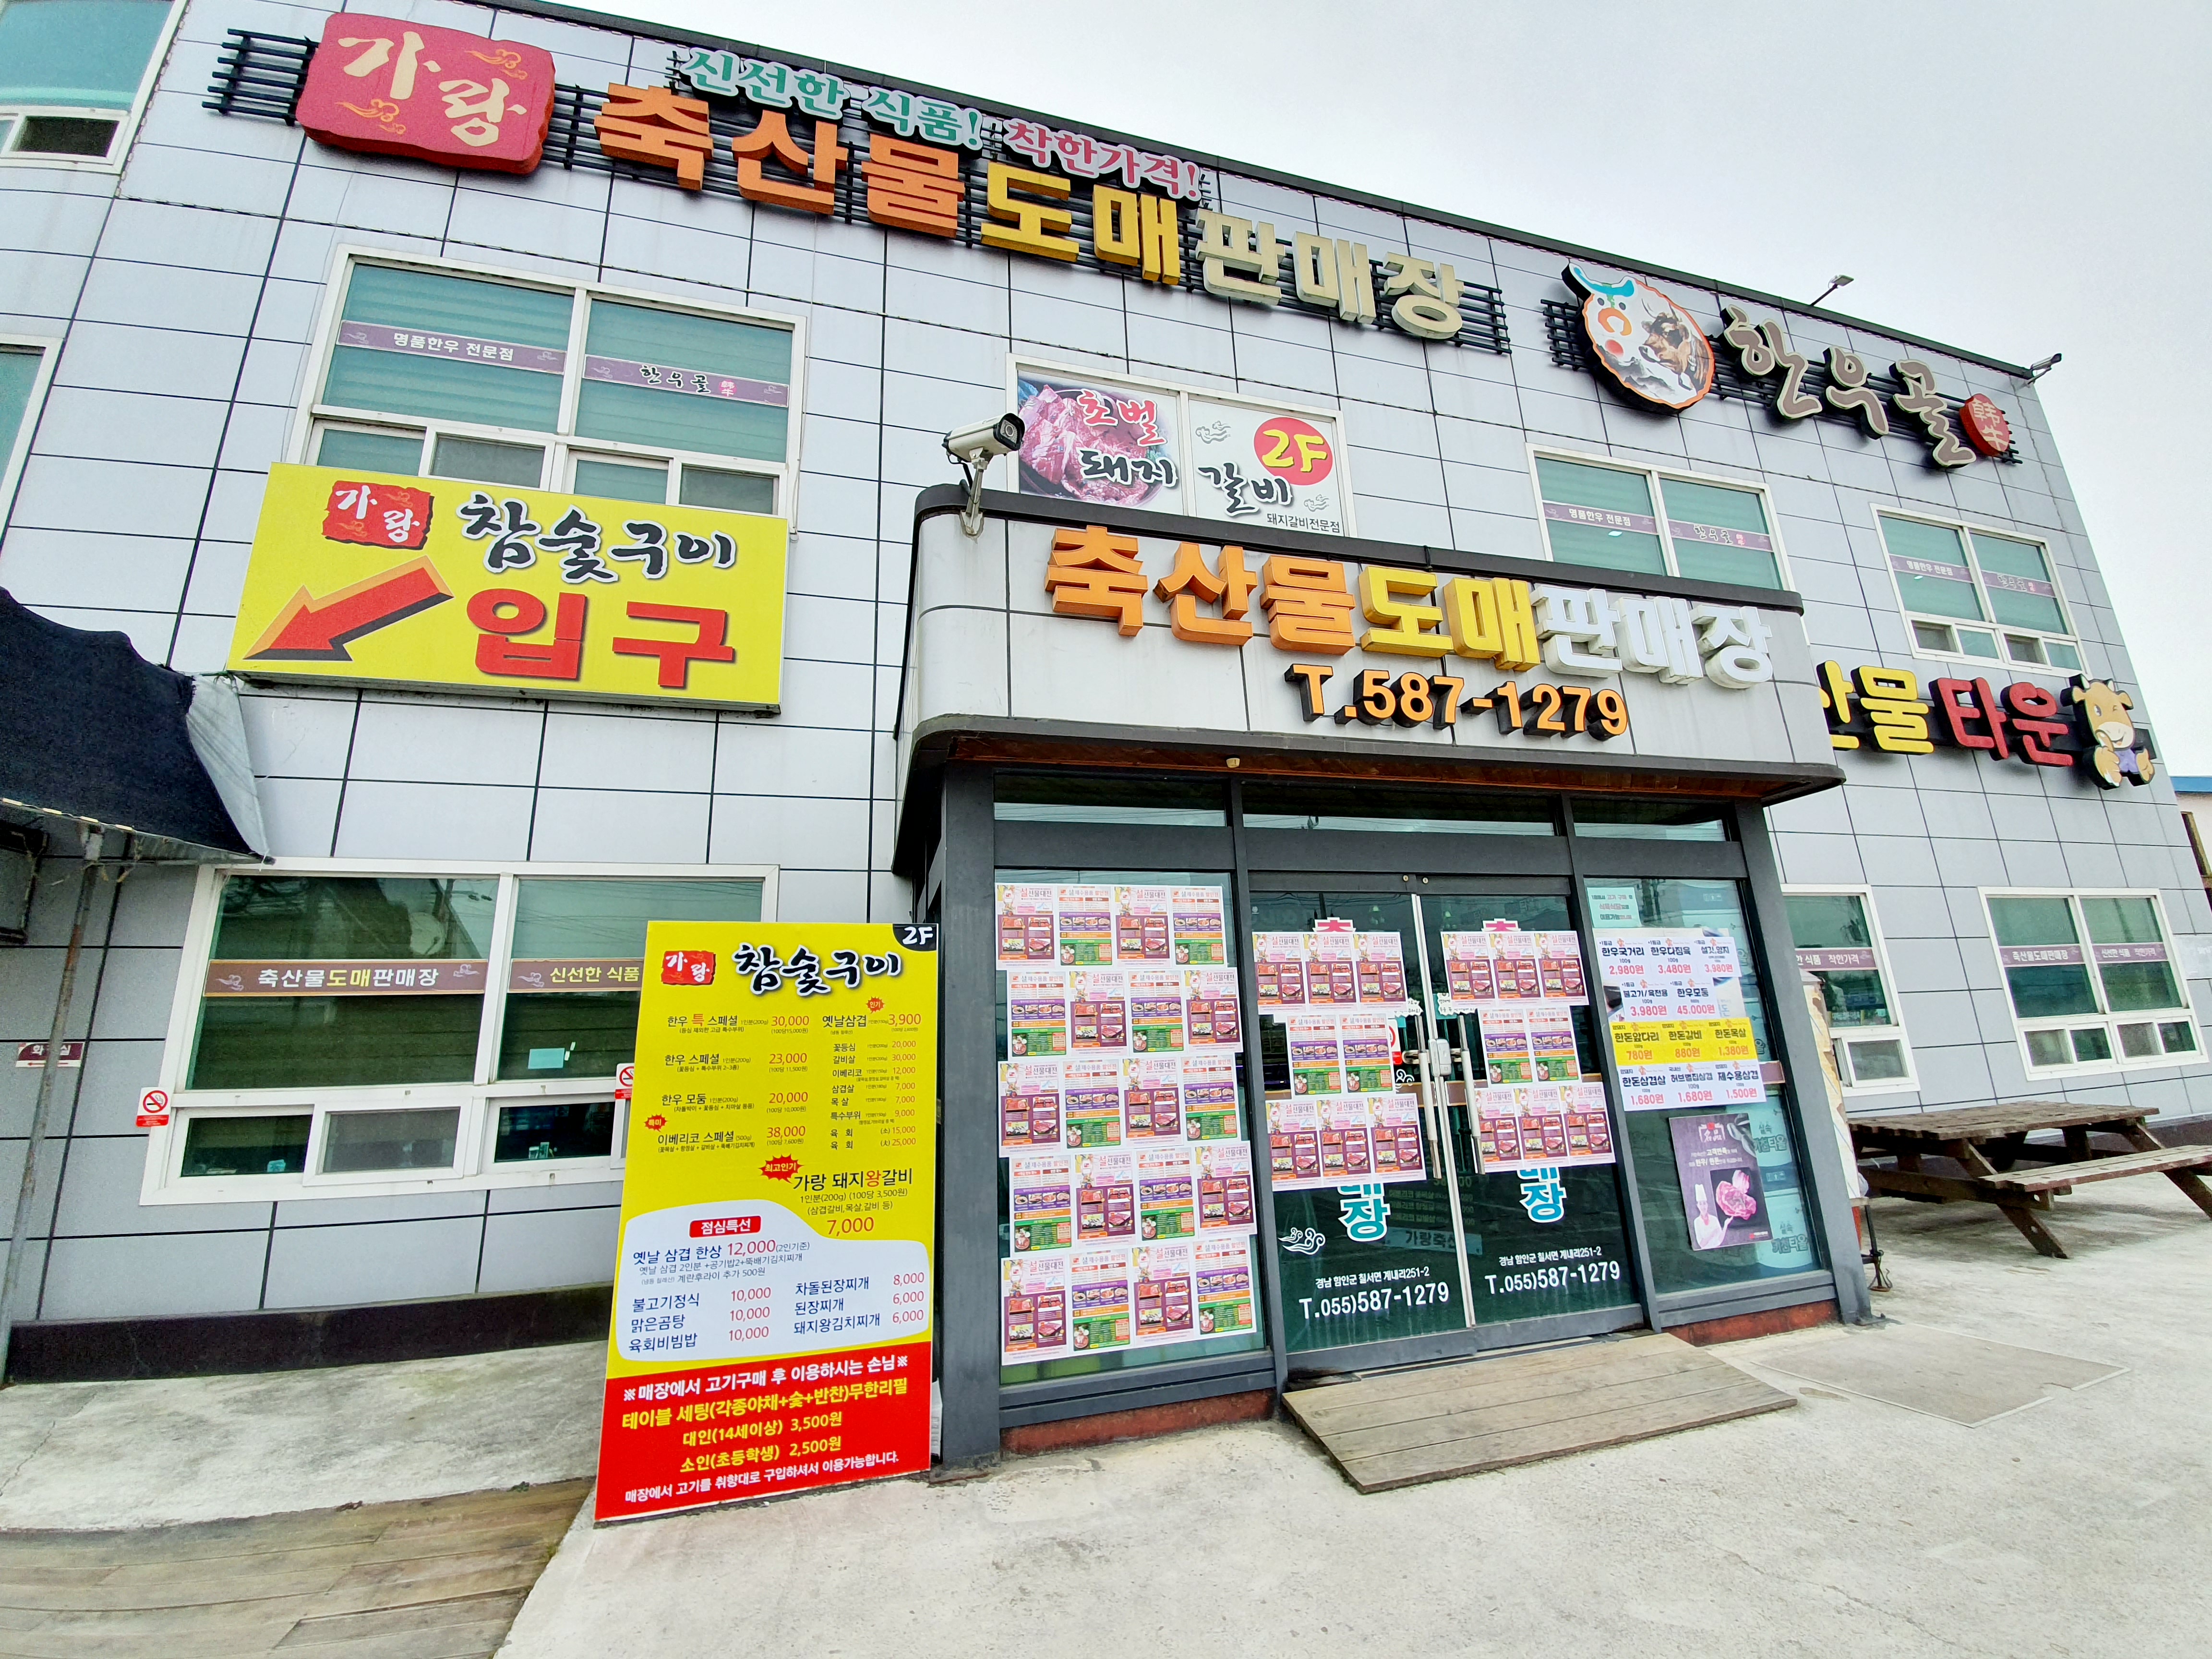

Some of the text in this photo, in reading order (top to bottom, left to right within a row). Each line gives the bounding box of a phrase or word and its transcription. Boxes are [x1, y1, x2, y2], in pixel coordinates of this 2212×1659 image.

[337, 31, 527, 146] 가랑
[685, 51, 977, 145] 신선한 식품!
[1008, 122, 1197, 200] 착한가격!
[593, 83, 1464, 339] 축산물도매판매장
[394, 333, 514, 361] 명품한우 전문점
[1724, 305, 1976, 466] 한우골
[1077, 389, 1167, 446] 초벌
[1262, 429, 1328, 472] 2F
[336, 483, 421, 543] 가랑
[1569, 508, 1631, 527] 명품한우 전문점
[1267, 513, 1340, 532] 돼지갈비전문점
[456, 491, 736, 584] 참숯구이
[1045, 526, 1772, 690] 축산물도매판매장
[466, 588, 735, 688] 입구
[1286, 663, 1626, 741] T.587-1279
[902, 926, 933, 946] 2F
[1602, 948, 1644, 956] 한우국거리
[1651, 947, 1691, 956] 한우다짐육
[1805, 955, 1821, 965] 식품
[550, 966, 639, 983] 신선한 식품
[666, 951, 710, 983] 가랑
[732, 942, 901, 997] 참숯구이
[1609, 965, 1644, 975] 2,980원
[1658, 964, 1691, 974] 3,480원
[1705, 964, 1733, 973] 3,980원
[257, 968, 438, 988] 축산물도매판매장
[1677, 988, 1708, 997] 한우모둠
[1630, 1005, 1667, 1017] 3,980원
[668, 1016, 688, 1027] 한우
[692, 1014, 704, 1027] 특
[707, 1015, 738, 1026] 스페셜
[771, 1015, 810, 1027] 30,000
[822, 1013, 921, 1027] 옛날삼겹 3,900
[1615, 1032, 1659, 1043] 한돈앞다리
[1669, 1030, 1702, 1041] 한돈갈비
[33, 1045, 71, 1056] 화실
[833, 1043, 855, 1052] 꽃등심
[1626, 1050, 1652, 1060] 780원
[1675, 1047, 1700, 1058] 880원
[665, 1055, 685, 1066] 한우
[688, 1054, 720, 1065] 스페셜
[769, 1053, 807, 1065] 23,000
[833, 1053, 916, 1064] 갈비살 30,000
[832, 1067, 916, 1078] 이베리코 12,000
[1623, 1075, 1665, 1087] 한돈삼겹살
[1718, 1070, 1759, 1081] 제수용삼겹
[832, 1082, 915, 1094] 삼겹살 7,000
[1678, 1090, 1713, 1102] 1,680원
[1726, 1088, 1757, 1099] 1,500원
[661, 1094, 682, 1106] 한우
[685, 1094, 707, 1105] 모둠
[769, 1092, 808, 1105] 20,000
[896, 1096, 915, 1104] 7,000
[1631, 1094, 1664, 1106] 1,680원
[830, 1109, 915, 1120] 특수부위 9,000
[658, 1133, 699, 1145] 이베리코
[703, 1131, 734, 1142] 스페셜
[767, 1126, 806, 1139] 38,000
[892, 1126, 916, 1134] 15,000
[892, 1138, 916, 1146] 25,000
[765, 1163, 796, 1172] 최고인기
[793, 1168, 912, 1192] 가랑 돼지왕갈비
[800, 1188, 908, 1203] 1인분(200g) (100당 3,500원)
[883, 1201, 892, 1210] 등)
[701, 1218, 751, 1235] 점심특선
[827, 1217, 874, 1237] 7,000
[633, 1250, 660, 1265] 옛날
[665, 1247, 691, 1262] 삼겹
[696, 1244, 721, 1260] 한상
[1499, 1255, 1514, 1267] 경남
[1537, 1250, 1558, 1262] 칠서면
[639, 1265, 657, 1276] 옛날
[660, 1264, 676, 1274] 삼겹
[679, 1262, 701, 1272] 2인분
[677, 1267, 765, 1283] 계란후라이 추가 500원
[795, 1272, 925, 1296] 차돌된장찌개 8,000
[1316, 1277, 1332, 1289] 경남
[1358, 1273, 1382, 1285] 칠서면
[1485, 1261, 1620, 1295] T.055)587-1279
[632, 1286, 771, 1312] 불고기정식 10,000
[794, 1290, 924, 1315] 된장찌개 6,000
[1299, 1282, 1449, 1320] T.055)587-1279
[631, 1306, 770, 1334] 맑은곰탕 10,000
[794, 1310, 924, 1335] 돼지왕김치찌개 6,000
[628, 1326, 769, 1353] 육회비빔밥 10,000
[706, 1370, 766, 1393] 고기구매
[771, 1370, 786, 1385] 후
[791, 1361, 863, 1381] 이용하시는
[622, 1408, 673, 1430] 테이블
[683, 1411, 842, 1447] 대인(14세이상) 3,500원
[680, 1436, 842, 1474] 소인(초등학생) 2,500원
[625, 1485, 673, 1503] 매장에서
[676, 1479, 711, 1495] 고기를
[715, 1472, 761, 1490] 취향대로
[764, 1463, 819, 1482] 구입하셔서
